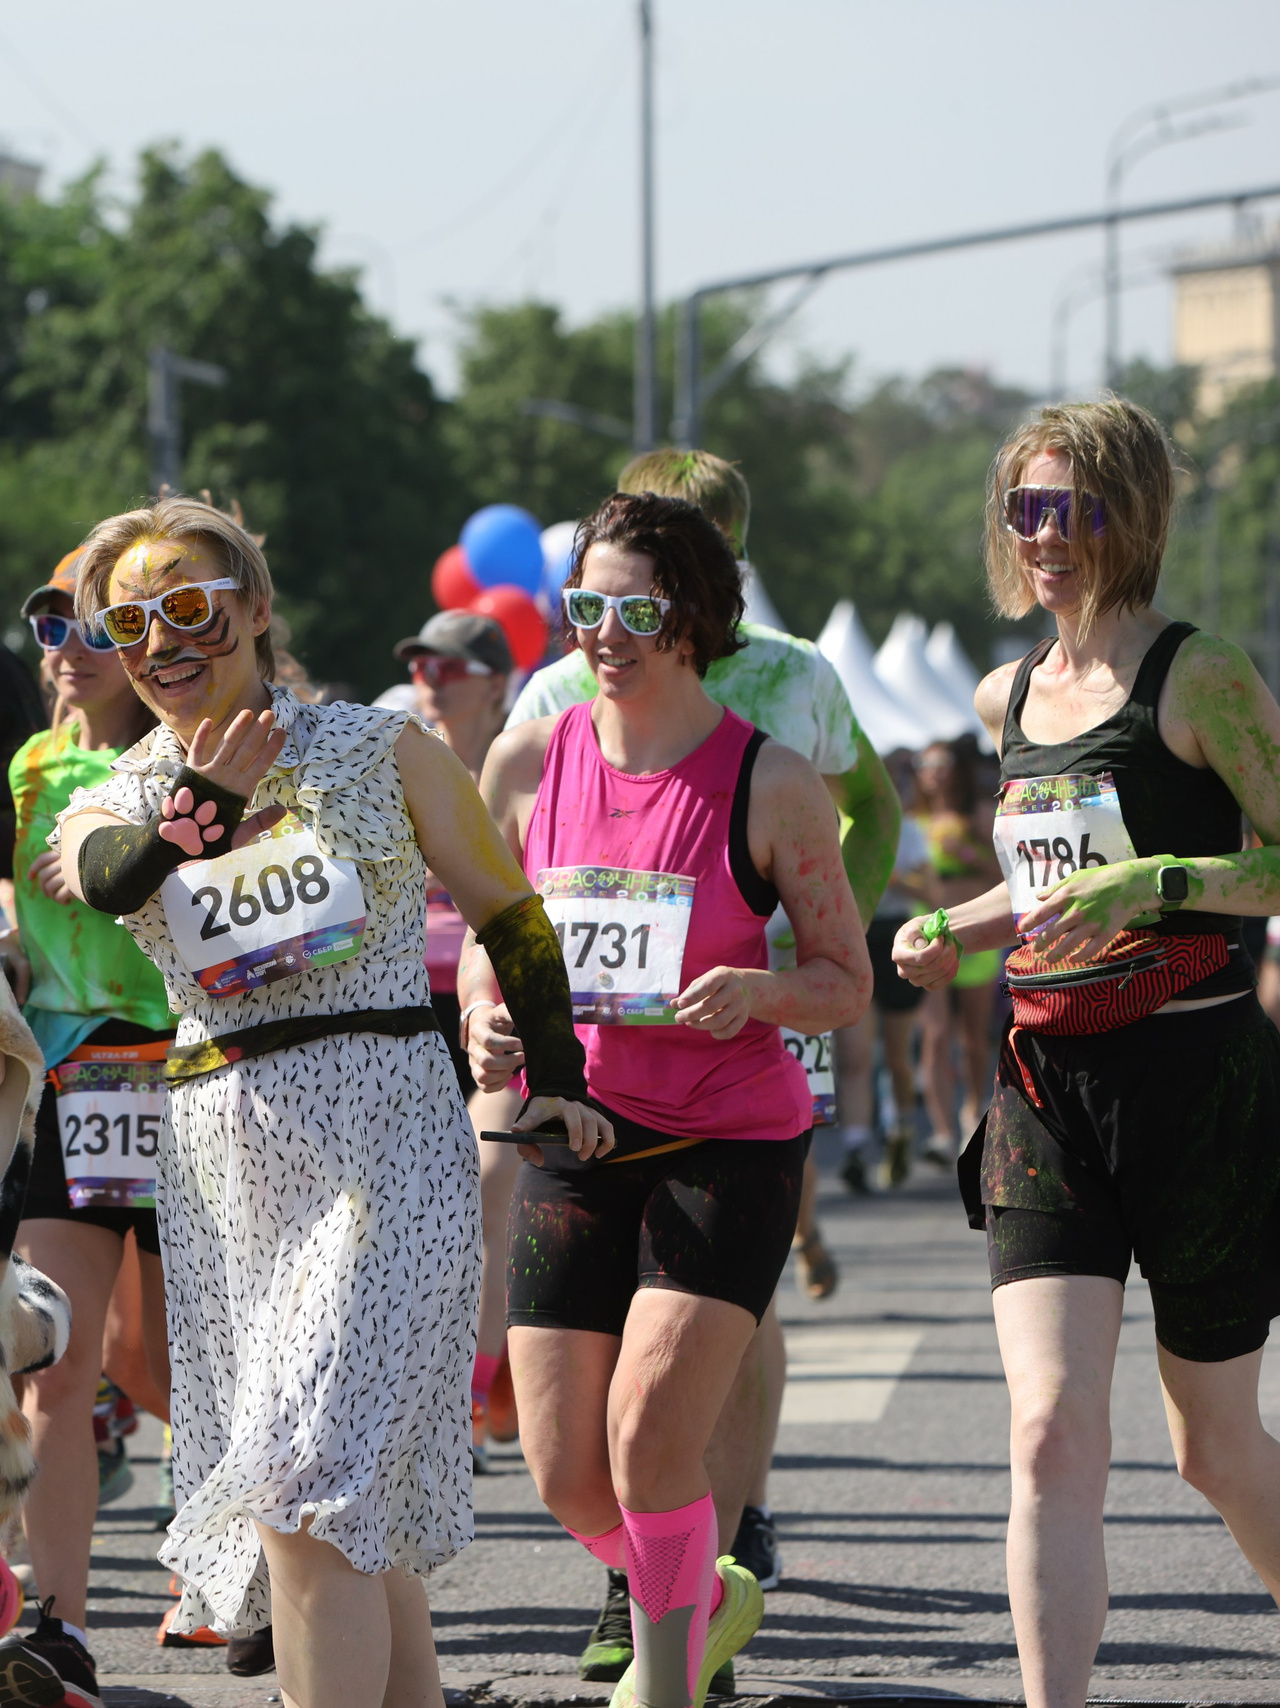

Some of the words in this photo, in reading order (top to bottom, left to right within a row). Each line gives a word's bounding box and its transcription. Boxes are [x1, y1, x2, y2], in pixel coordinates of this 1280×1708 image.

[191, 854, 330, 942] 2608
[312, 945, 333, 956] СБЕР
[65, 1113, 161, 1158] 2315
